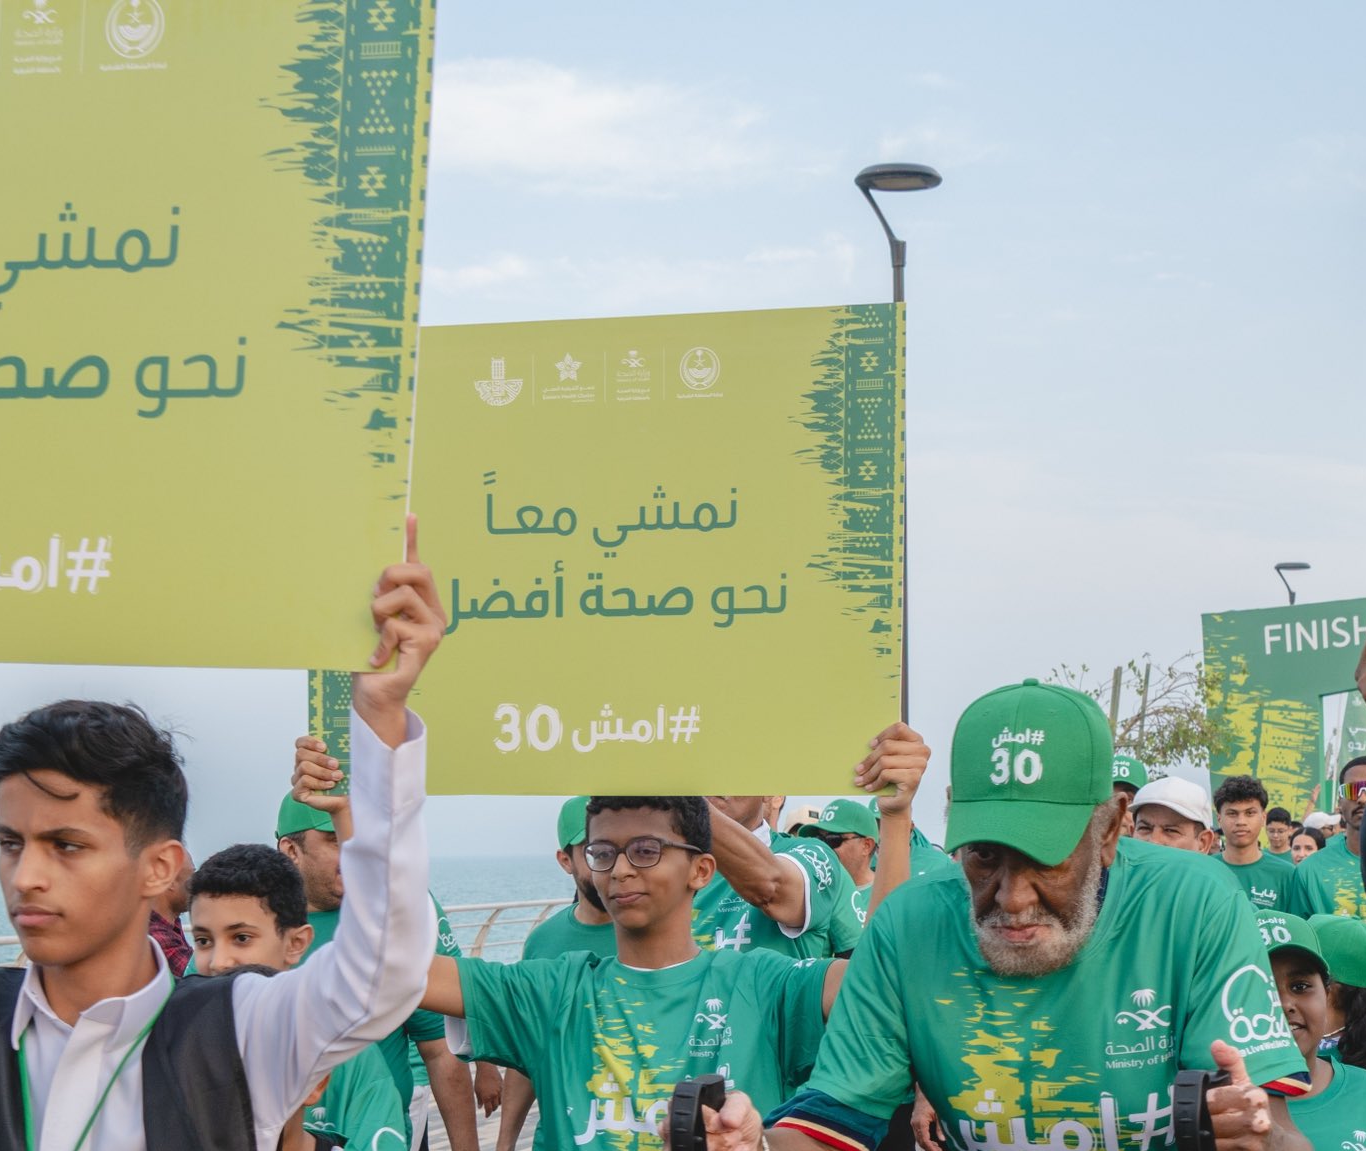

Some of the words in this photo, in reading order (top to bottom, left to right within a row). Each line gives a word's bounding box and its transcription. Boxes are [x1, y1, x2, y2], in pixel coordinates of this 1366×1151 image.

[134, 336, 247, 419] نحو
[592, 485, 738, 558] نمشي
[579, 571, 694, 617] صحة
[710, 572, 788, 627] نحو
[492, 703, 563, 753] 30
[570, 703, 700, 753] #امش
[991, 726, 1045, 748] #امش
[989, 747, 1044, 786] 30
[1105, 1036, 1155, 1056] الصحة
[1105, 1057, 1145, 1070] Ministry
[1147, 1054, 1160, 1066] of
